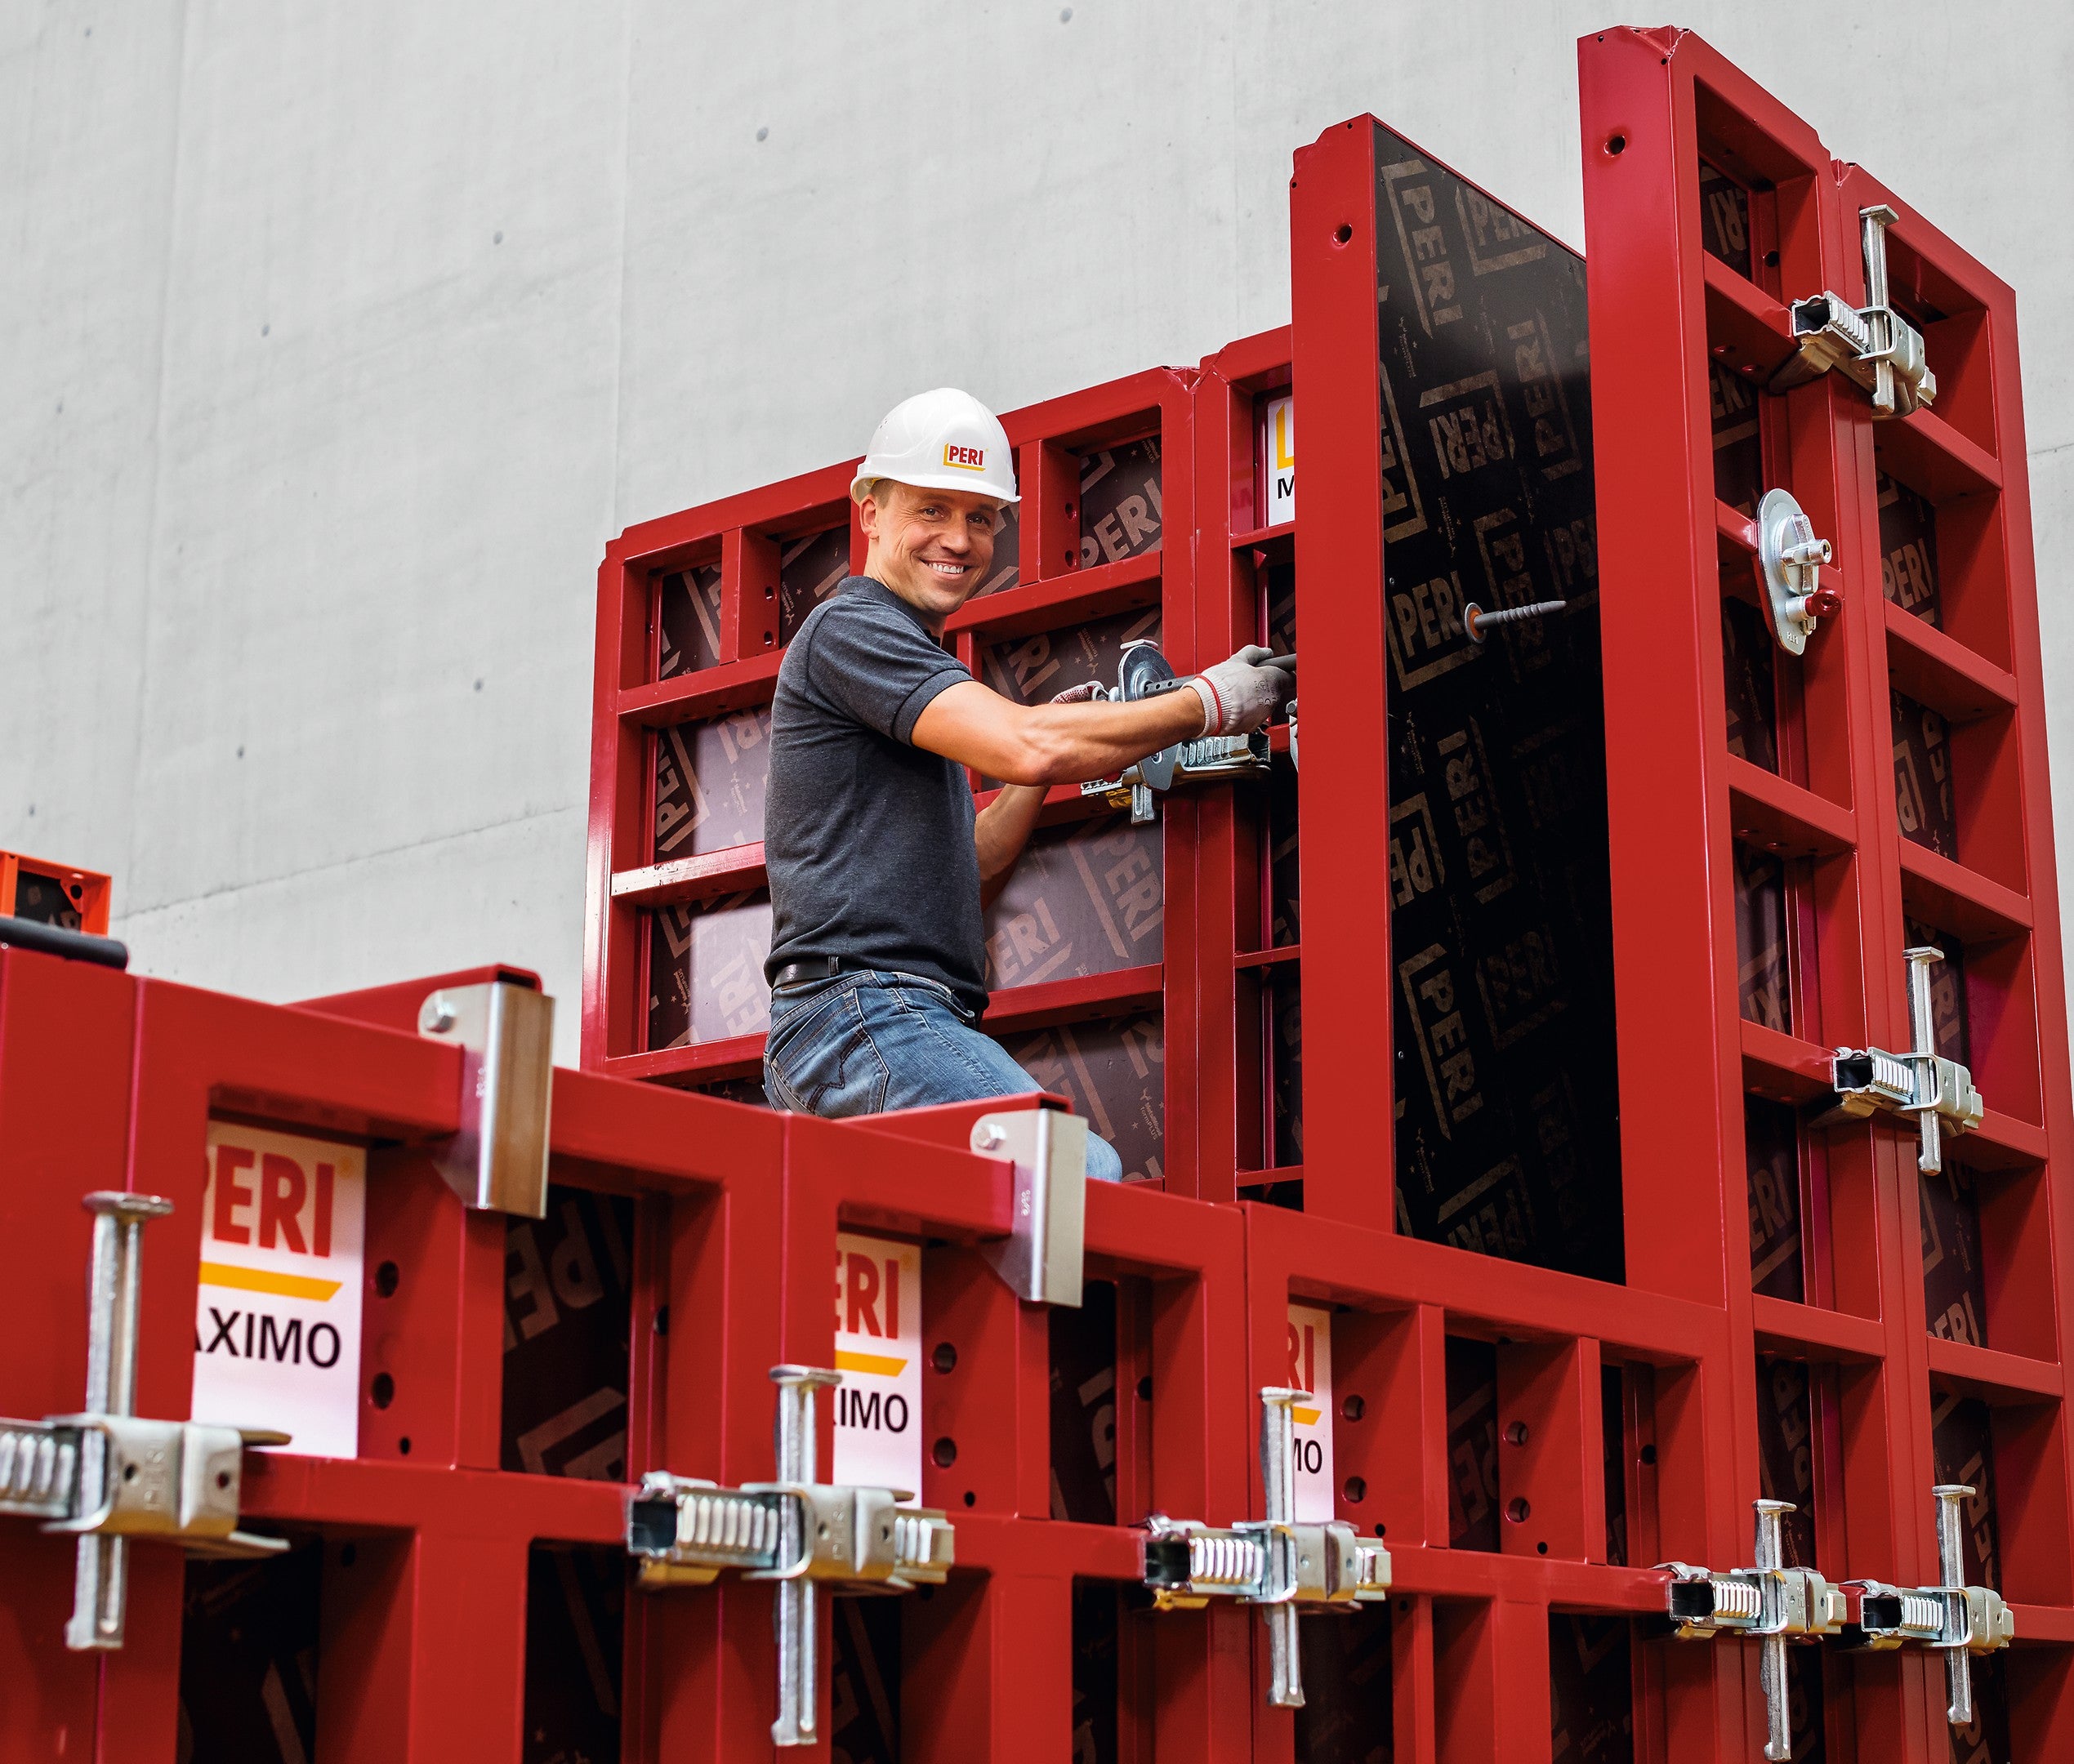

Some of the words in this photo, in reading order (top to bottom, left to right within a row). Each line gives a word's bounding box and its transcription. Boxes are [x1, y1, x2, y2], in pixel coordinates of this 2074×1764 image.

[1401, 185, 1464, 326] PERI
[1507, 319, 1567, 457] PERI
[948, 445, 984, 466] PERI
[1429, 399, 1505, 480] PERI
[1080, 478, 1162, 568] PERI
[1392, 569, 1467, 659] PERI
[1492, 531, 1553, 673] PERI
[1884, 537, 1935, 611] PERI
[1438, 728, 1501, 879] PERI
[1390, 825, 1434, 913] PE
[985, 897, 1060, 985] ERI
[1419, 968, 1484, 1125] PERI
[203, 1145, 335, 1258] ERI
[506, 1200, 606, 1353] PE
[195, 1307, 341, 1370] XIMO
[832, 1388, 908, 1432] IMO
